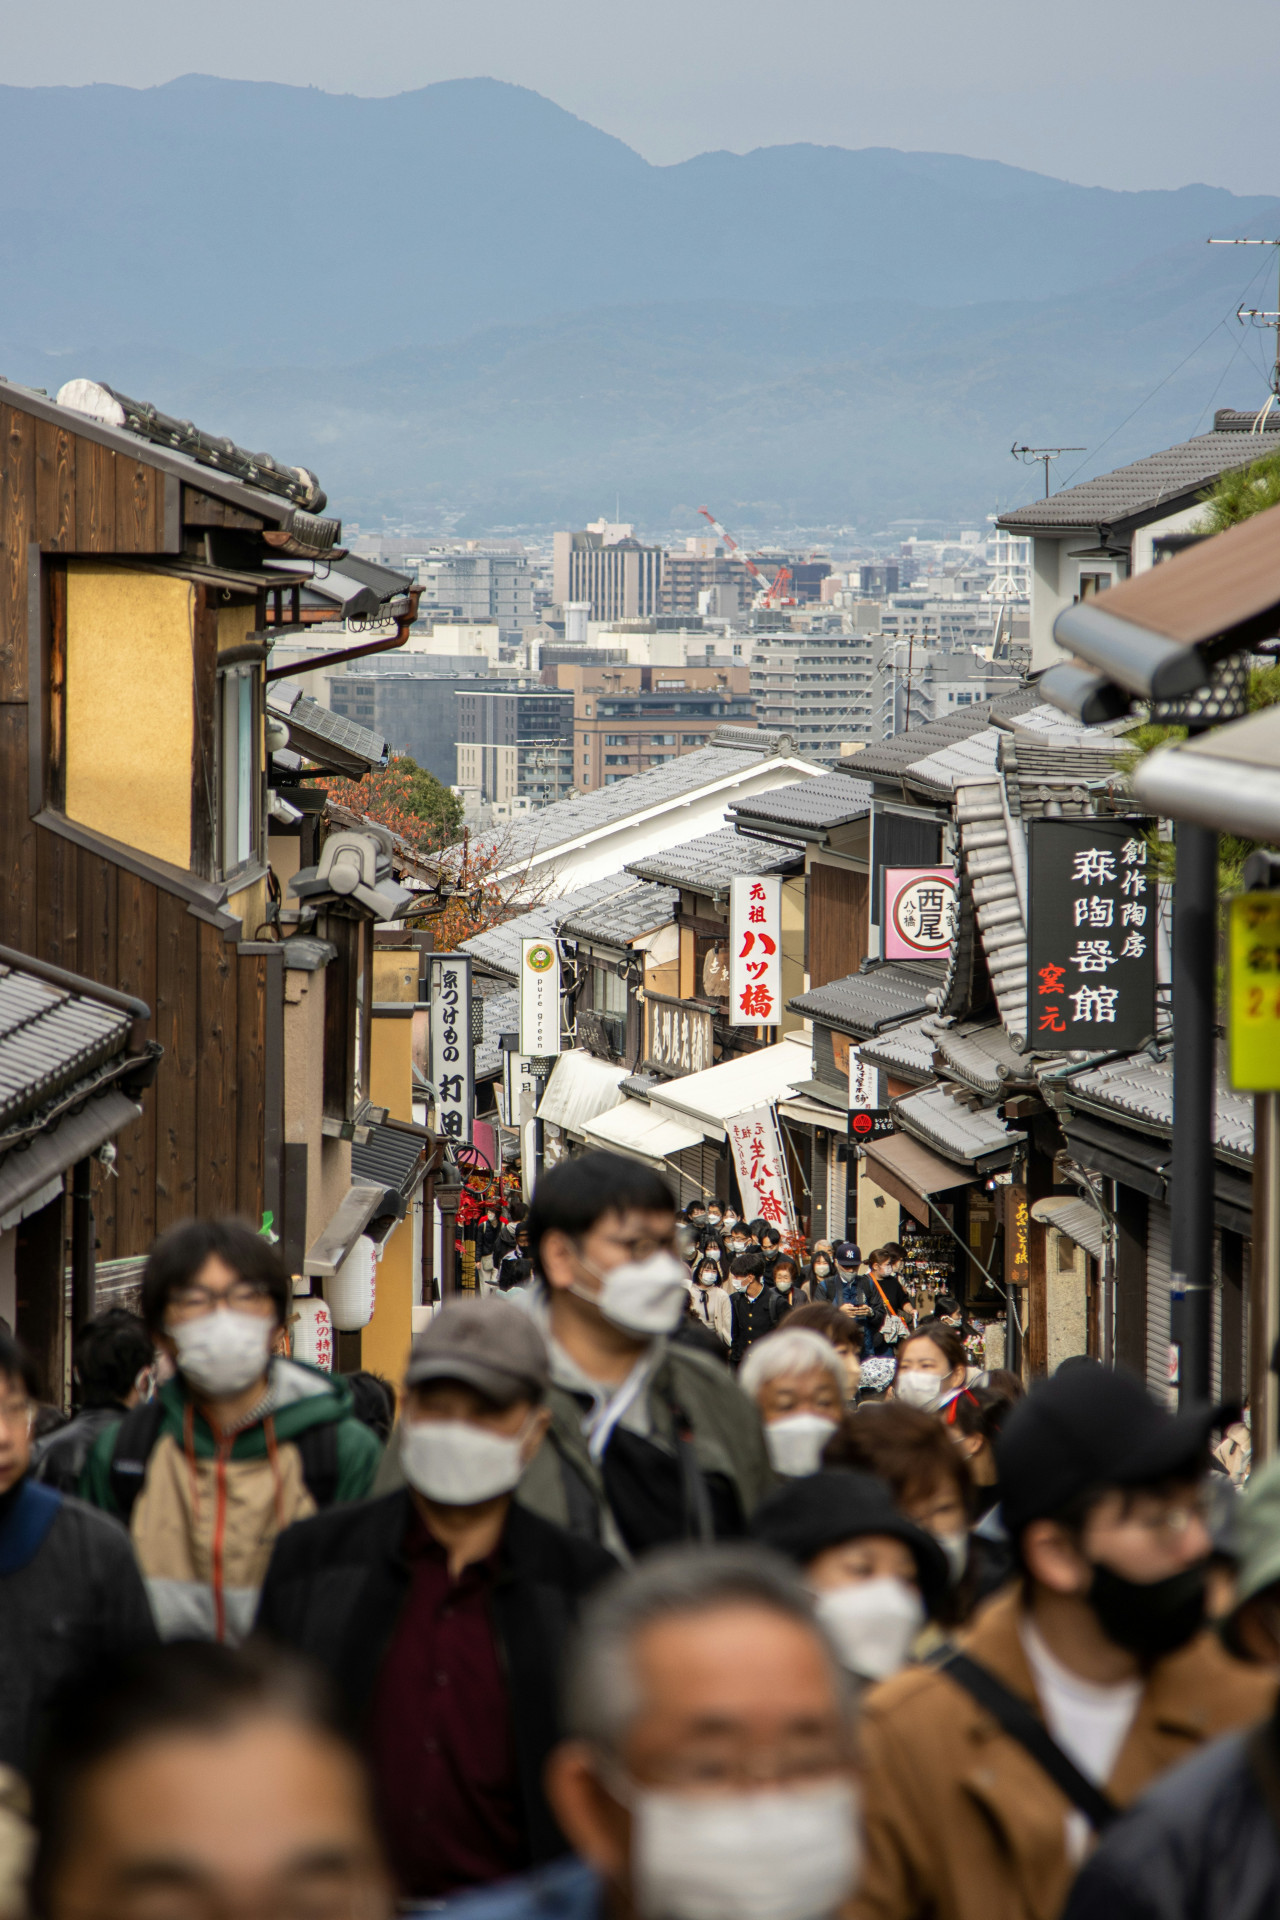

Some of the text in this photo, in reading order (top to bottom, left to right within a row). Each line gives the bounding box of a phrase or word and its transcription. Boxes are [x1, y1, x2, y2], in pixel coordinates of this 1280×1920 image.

[914, 888, 945, 940] 西尾
[1069, 848, 1119, 1023] 森陶器館
[1120, 838, 1147, 958] 創作陶房
[441, 970, 459, 1062] 京つけもの
[1038, 962, 1067, 1032] 窯元
